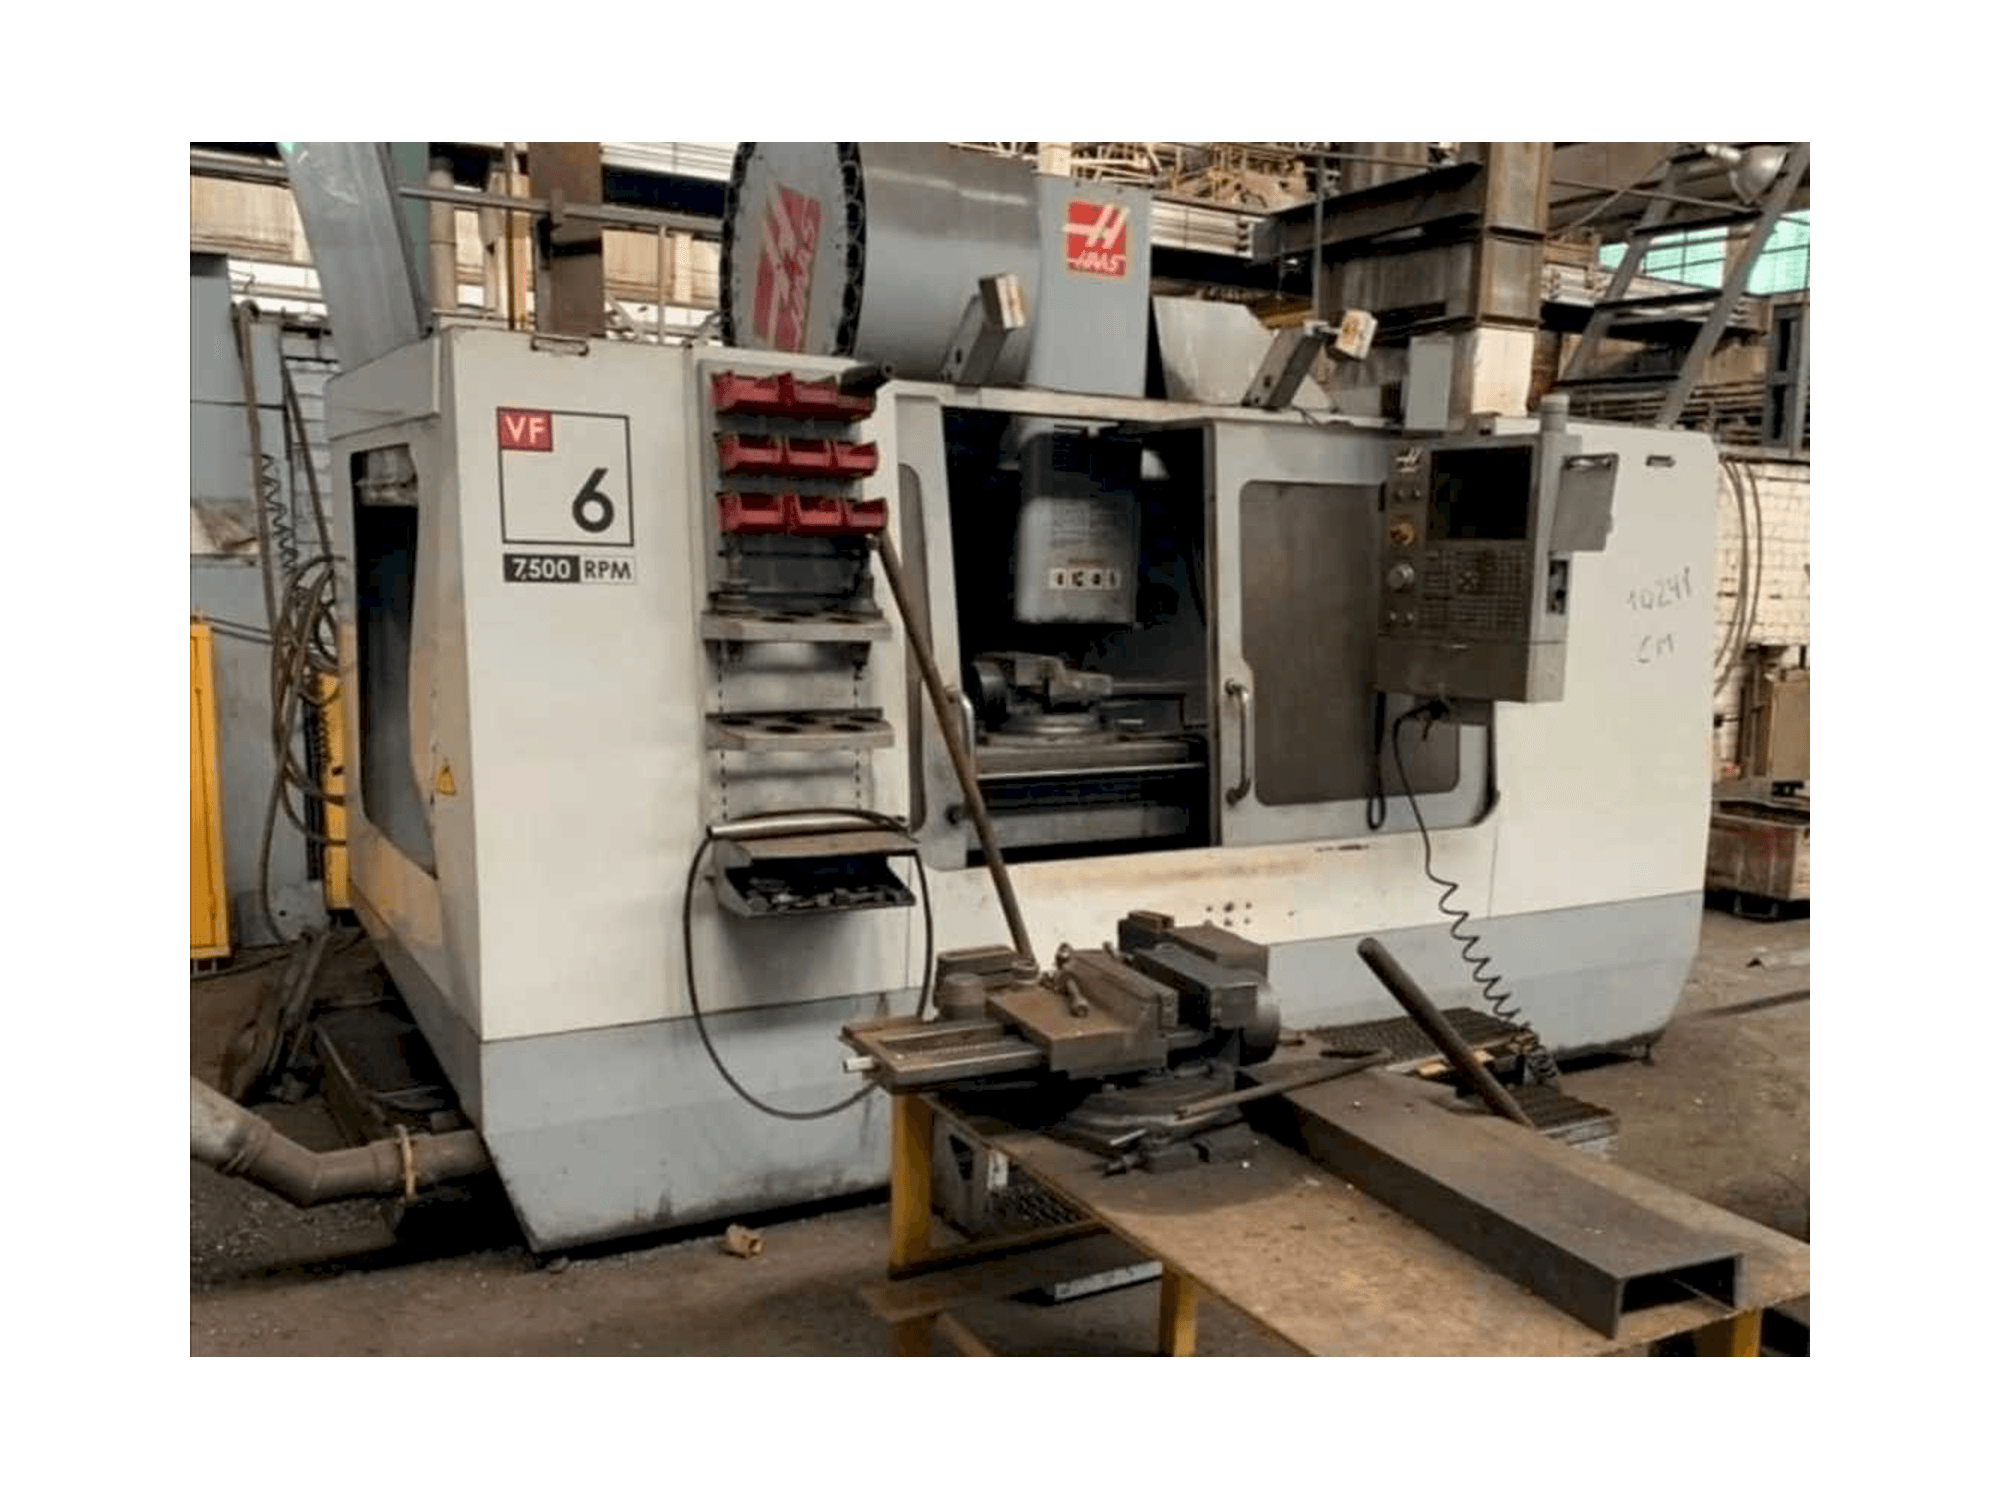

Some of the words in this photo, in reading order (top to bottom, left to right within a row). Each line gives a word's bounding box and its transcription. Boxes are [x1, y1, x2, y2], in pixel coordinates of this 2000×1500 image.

[504, 415, 545, 443] VF
[572, 467, 615, 533] 6
[584, 559, 632, 581] RPM
